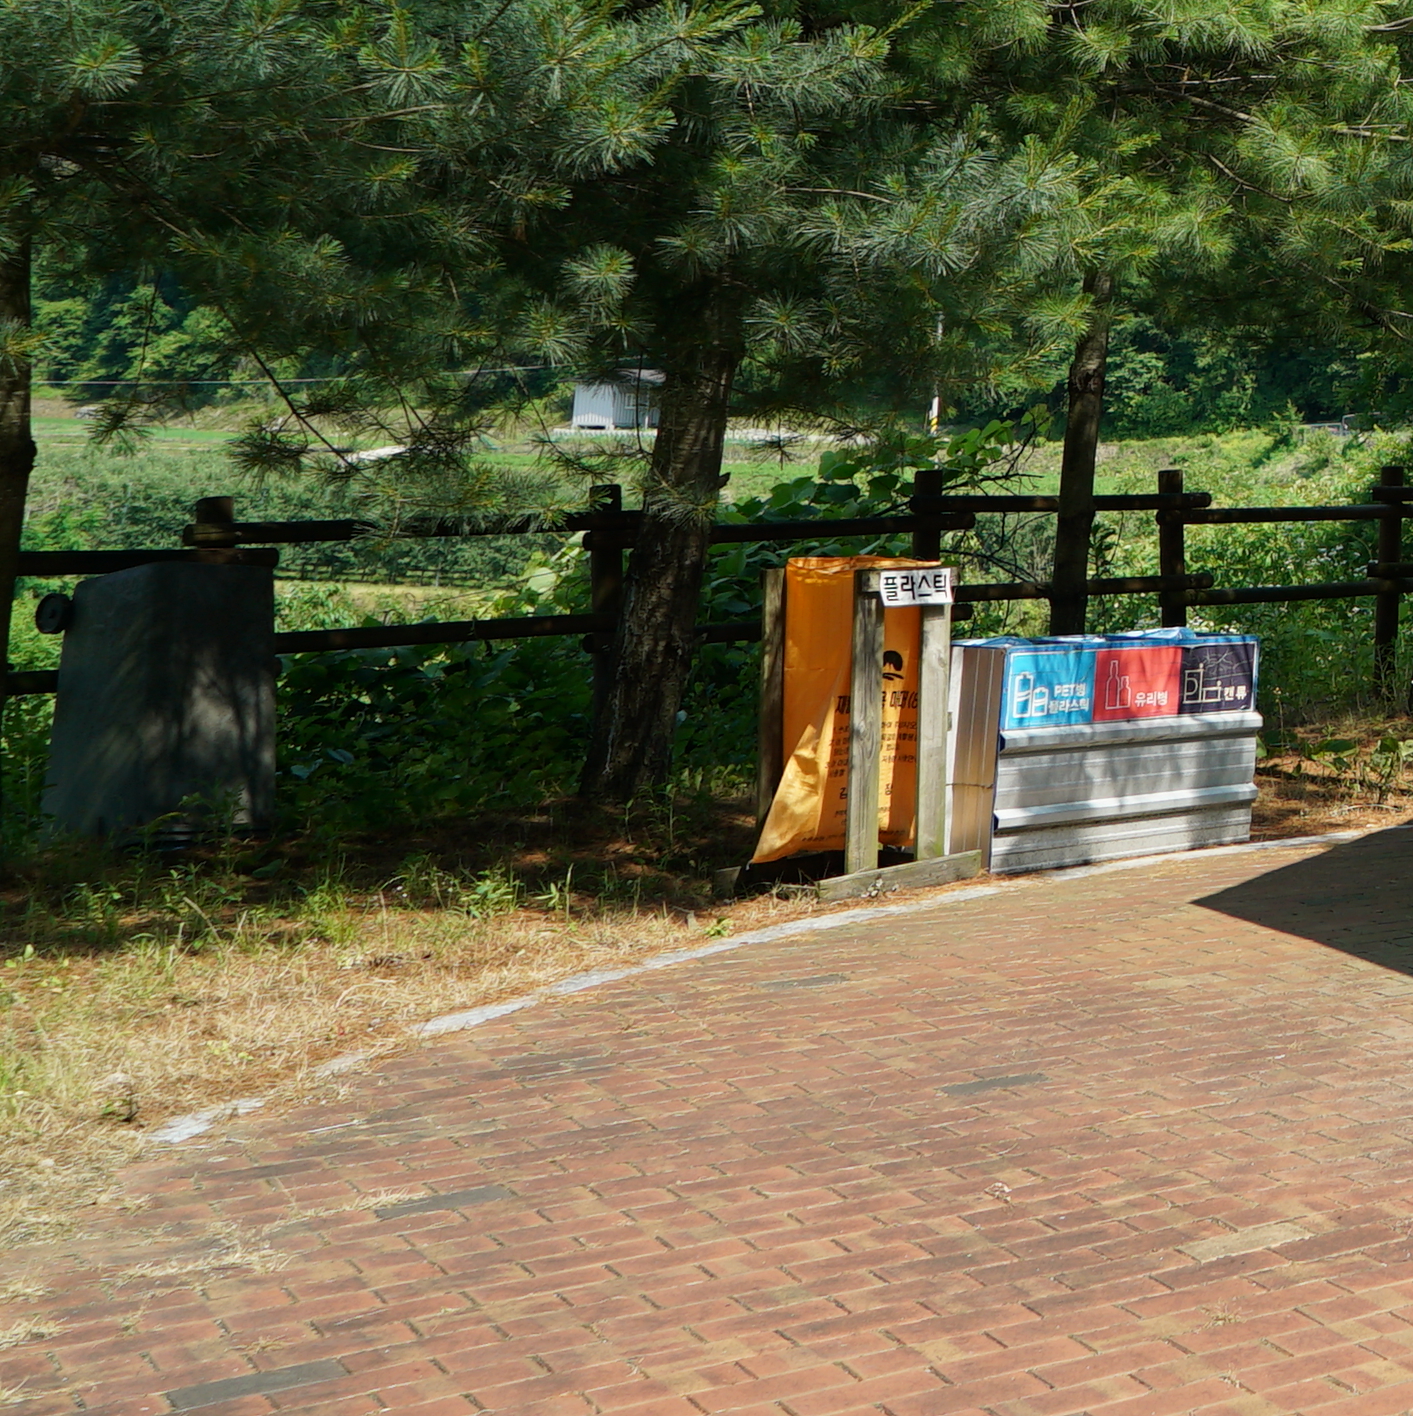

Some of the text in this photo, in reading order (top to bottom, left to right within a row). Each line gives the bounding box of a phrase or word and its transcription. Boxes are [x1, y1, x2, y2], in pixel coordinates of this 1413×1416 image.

[884, 572, 949, 602] 플라스틱
[1048, 697, 1091, 715] 플라스틱
[1134, 690, 1169, 708] 유리병
